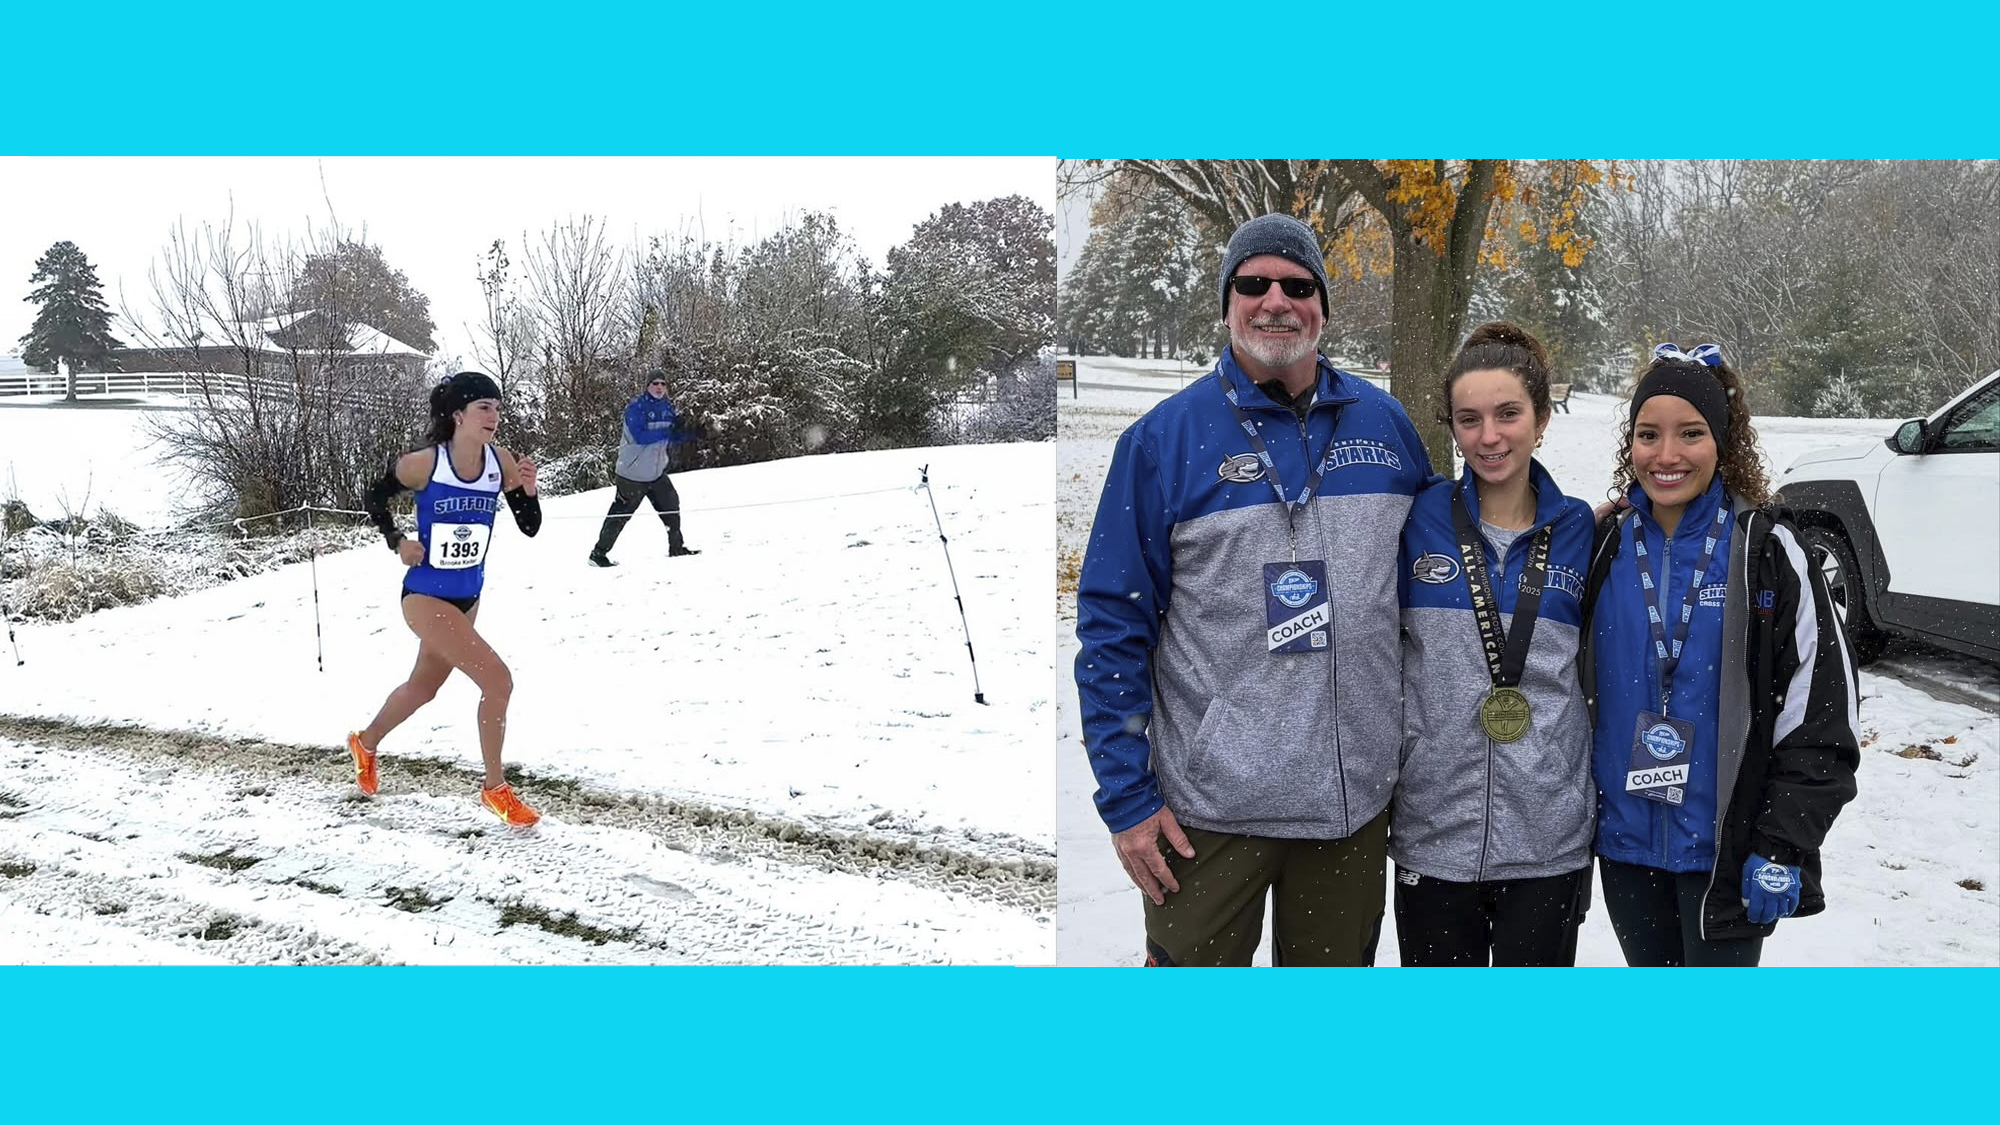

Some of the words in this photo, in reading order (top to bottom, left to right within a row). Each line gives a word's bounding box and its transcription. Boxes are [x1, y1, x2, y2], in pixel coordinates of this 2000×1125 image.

[1326, 446, 1402, 471] SHARKS
[440, 541, 479, 558] 1393
[1479, 566, 1492, 599] DIVISION
[1521, 585, 1541, 596] 2025
[1461, 544, 1501, 674] ALL-AMERICAN
[1272, 611, 1323, 642] COACH
[1632, 769, 1683, 786] COACH
